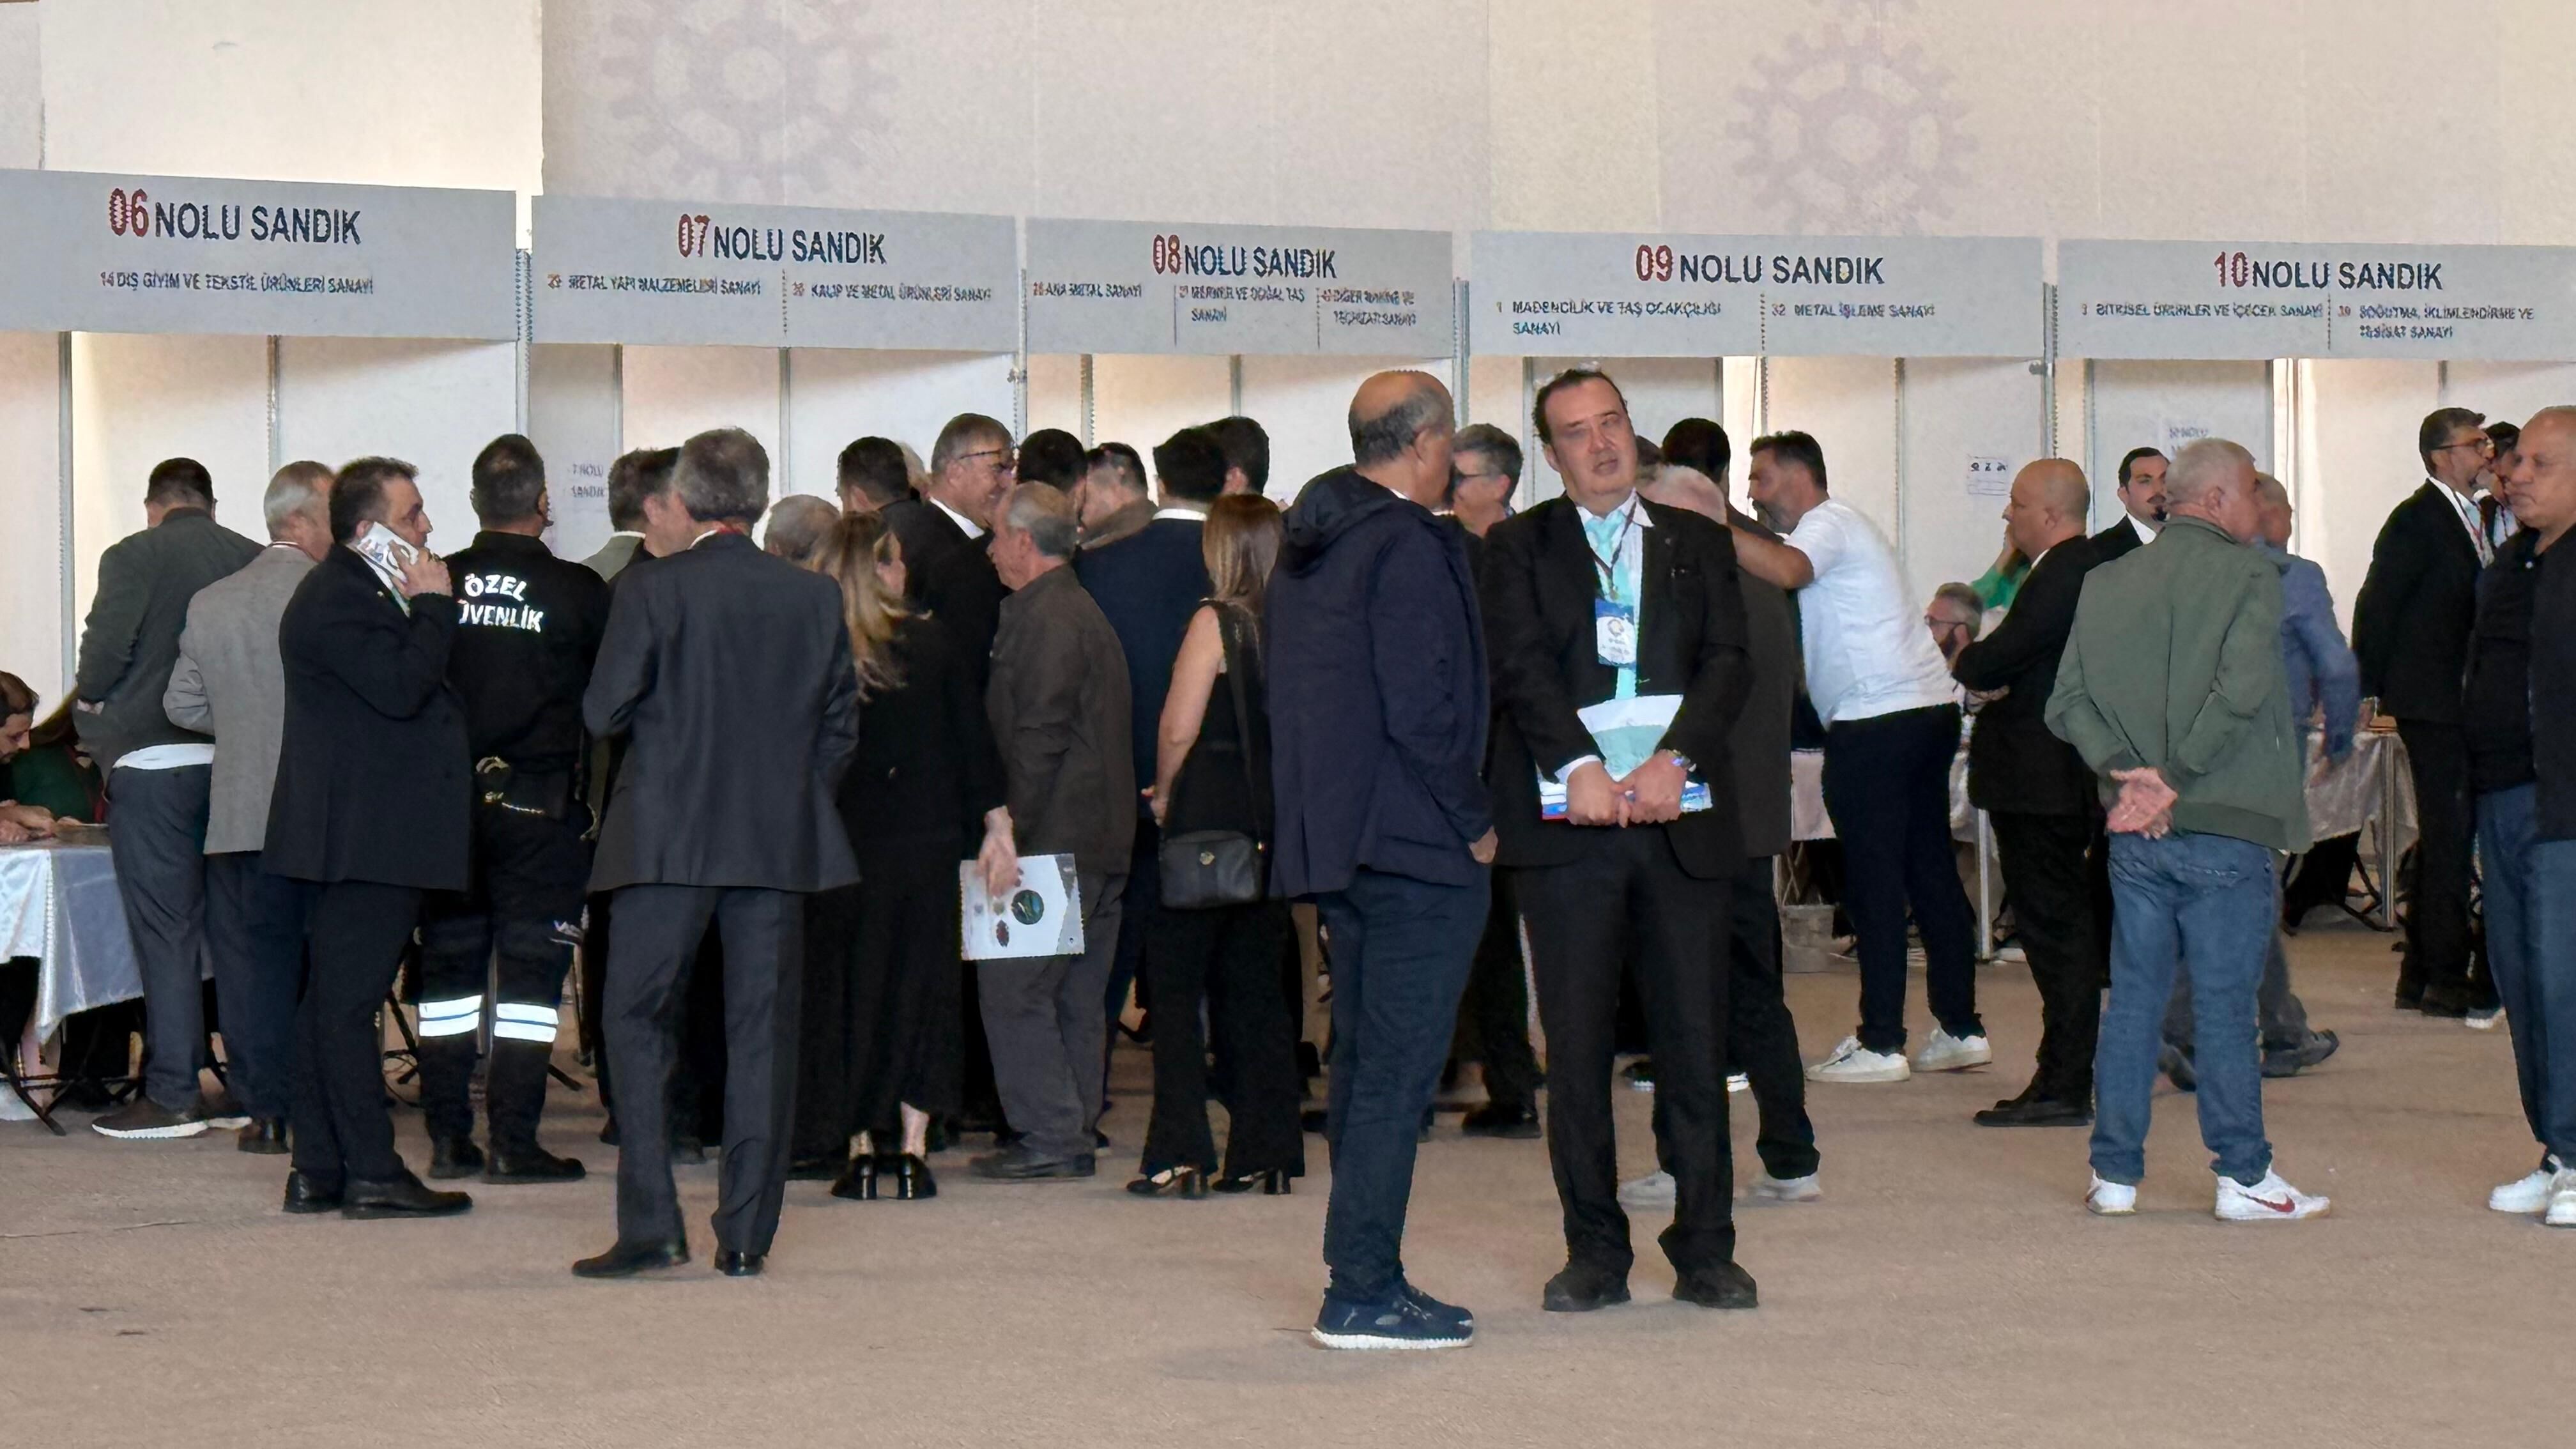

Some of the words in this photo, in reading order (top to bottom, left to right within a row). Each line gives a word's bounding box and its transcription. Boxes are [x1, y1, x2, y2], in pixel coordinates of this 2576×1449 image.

[109, 188, 148, 237] 06
[155, 202, 240, 240] NOLU
[250, 205, 362, 244] SANDIK
[678, 213, 710, 257] 07
[714, 226, 783, 261] NOLU
[792, 230, 887, 264] SANDIK
[1153, 234, 1181, 274] 08
[1184, 245, 1247, 276] NOLU
[1253, 246, 1338, 279] SANDIK
[183, 273, 201, 289] VE
[1636, 244, 1673, 282] 09
[1680, 255, 1762, 284] NOLU
[1772, 256, 1884, 286] SANDIK
[2214, 251, 2248, 288] 10
[2251, 260, 2329, 289] NOLU
[2338, 262, 2443, 291] SANDIK
[1597, 300, 1614, 314] VE
[1617, 302, 1643, 318] TAŞ
[2213, 303, 2230, 317] VE
[464, 572, 527, 602] ÖZEL
